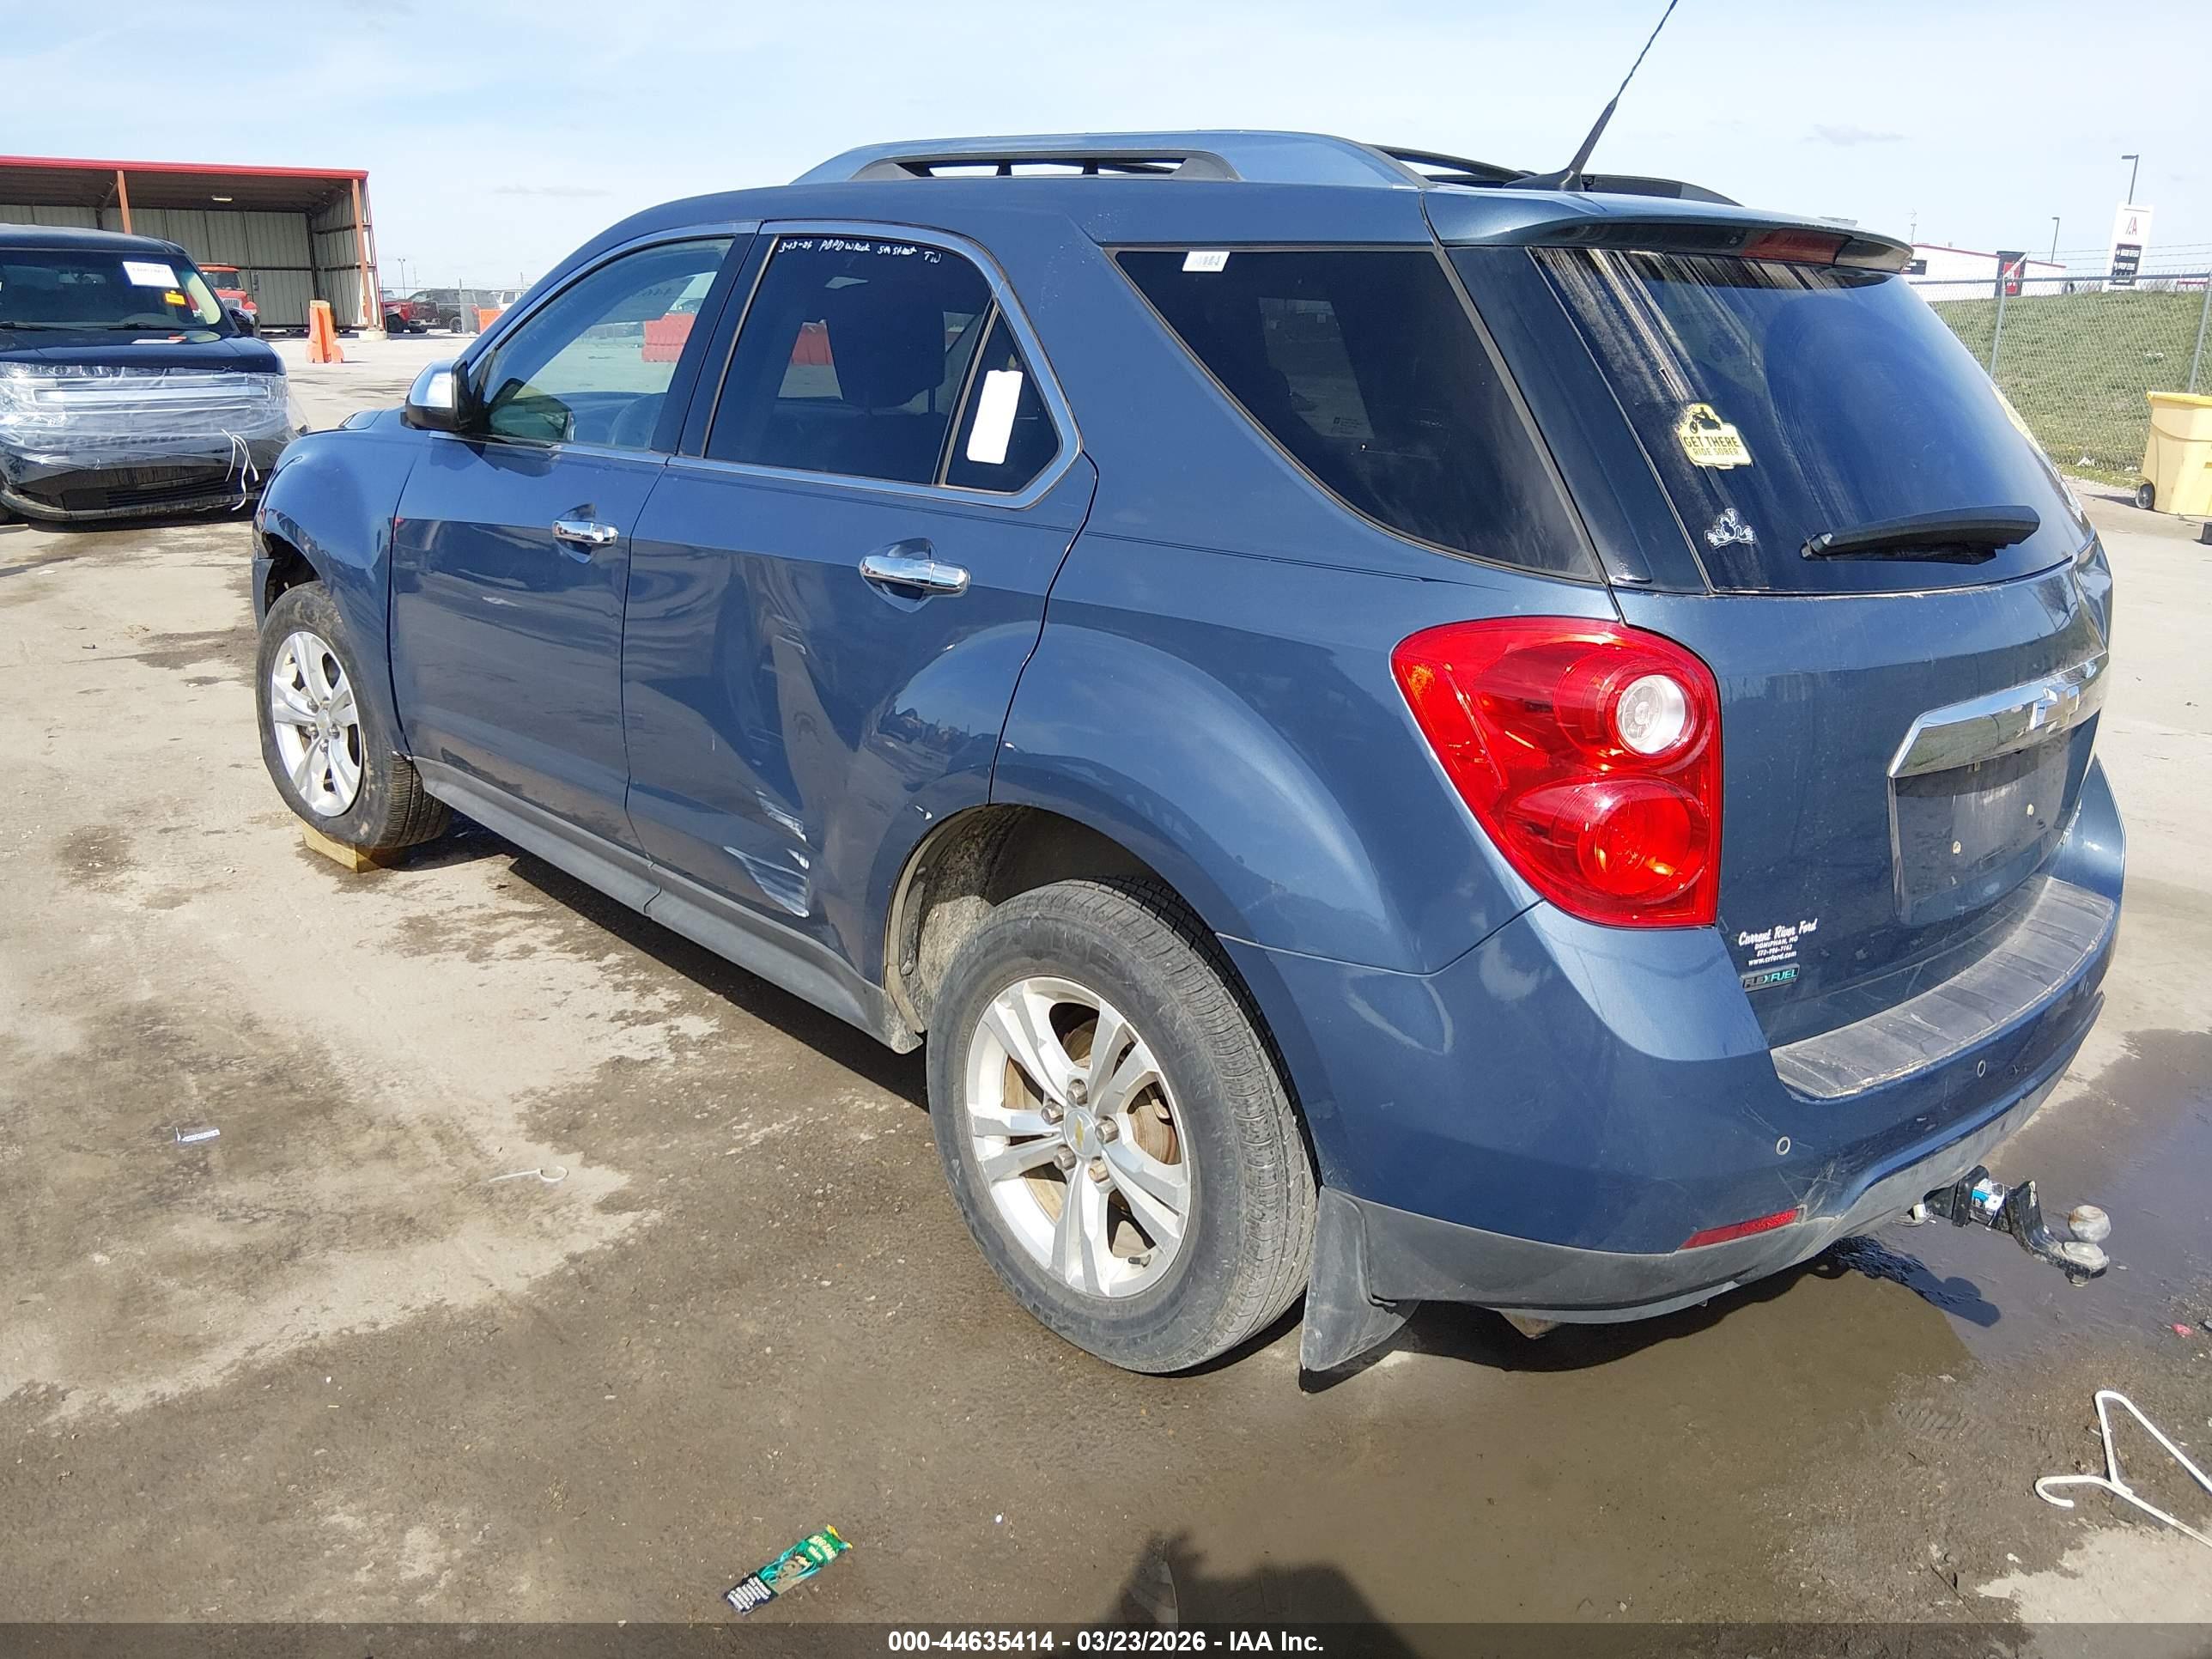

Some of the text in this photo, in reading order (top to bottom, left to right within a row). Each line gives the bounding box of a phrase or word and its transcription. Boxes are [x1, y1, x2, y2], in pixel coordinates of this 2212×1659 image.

[1683, 436, 1704, 447] GET
[1773, 925, 1796, 941] River
[1798, 918, 1819, 935] Ford
